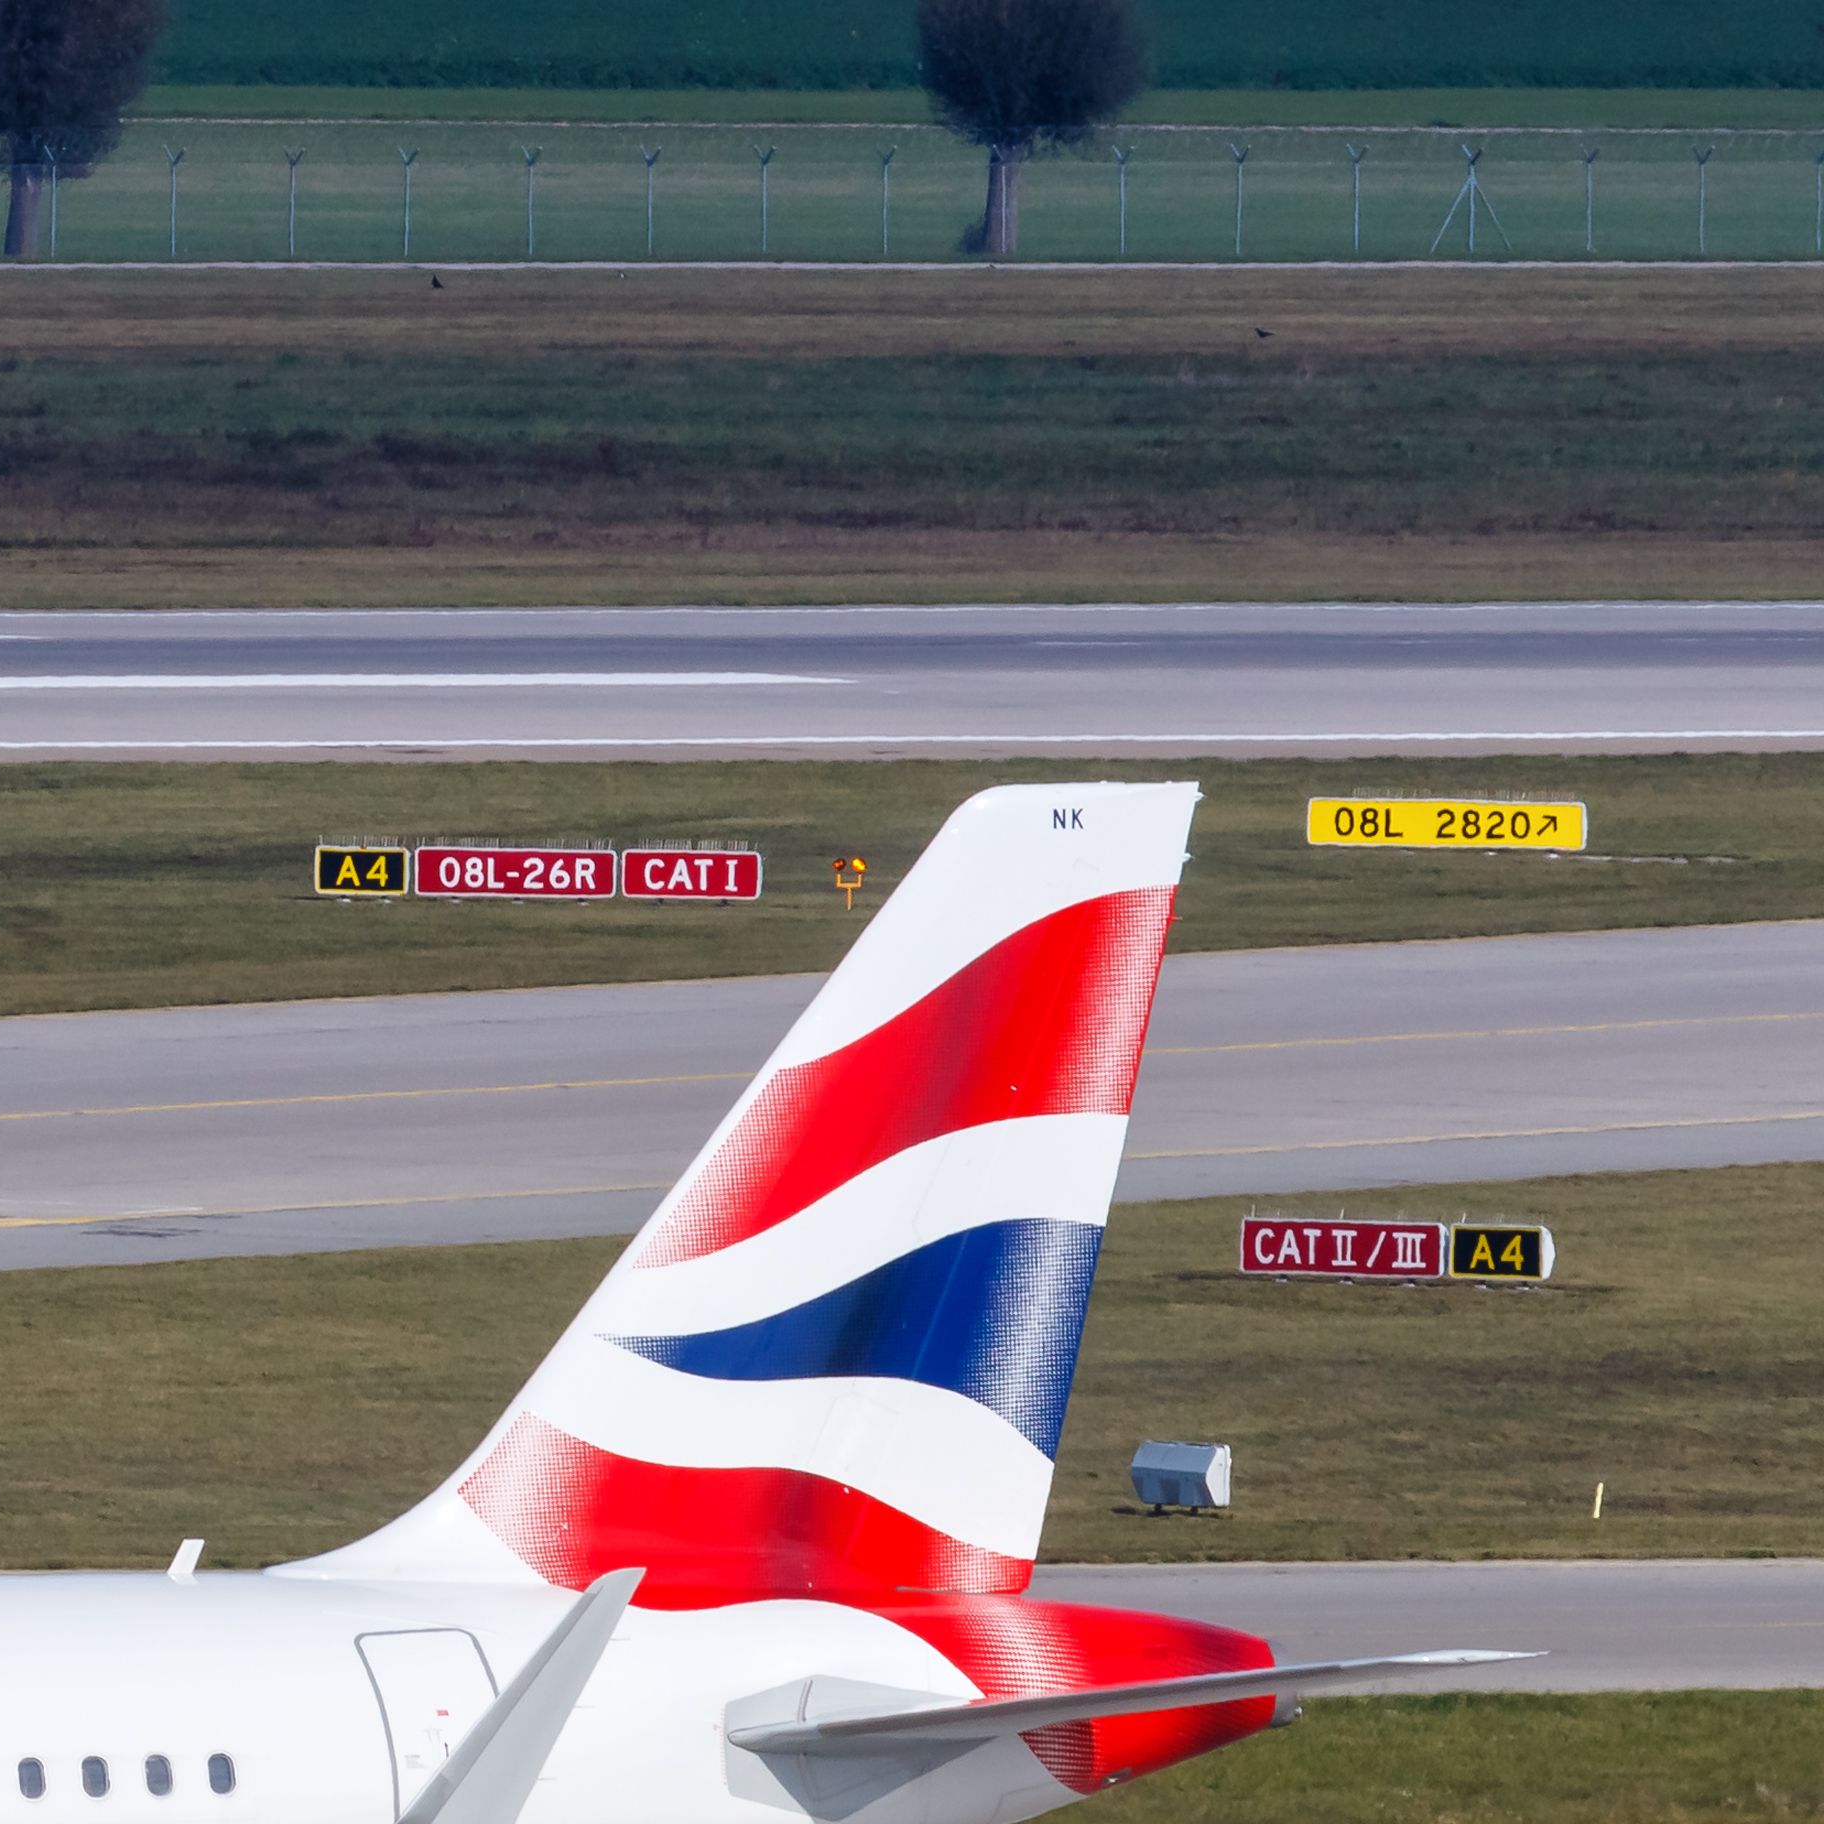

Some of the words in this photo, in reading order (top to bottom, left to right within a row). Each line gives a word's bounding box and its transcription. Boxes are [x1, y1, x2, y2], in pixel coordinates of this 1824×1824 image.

[1053, 808, 1084, 830] NK
[1334, 807, 1403, 838] 08L
[1436, 810, 1530, 840] 2820
[335, 855, 389, 887] A4
[439, 856, 596, 890] 08L-26R
[643, 859, 712, 891] CAT
[1254, 1228, 1322, 1265] CAT
[1469, 1233, 1525, 1271] A4
